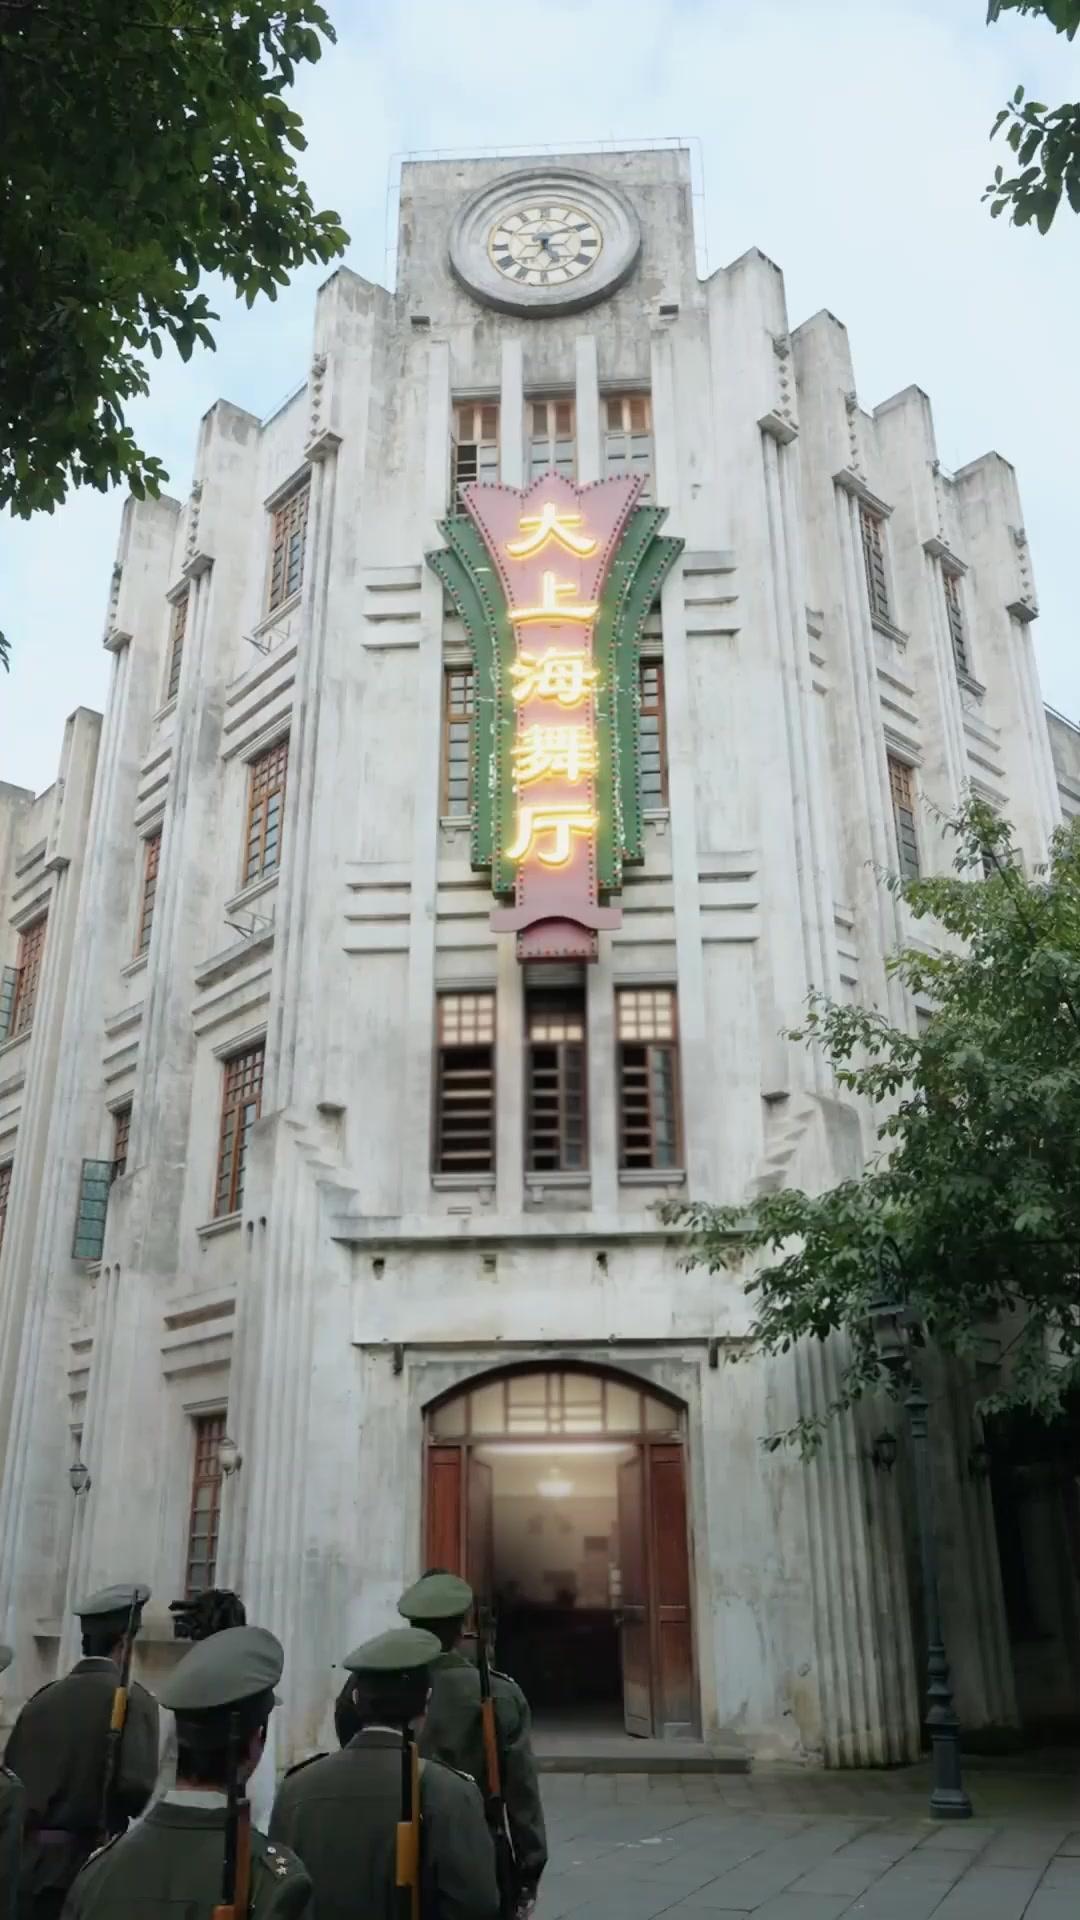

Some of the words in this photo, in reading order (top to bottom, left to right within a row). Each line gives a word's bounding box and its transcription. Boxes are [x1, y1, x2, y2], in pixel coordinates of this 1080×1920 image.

[505, 502, 599, 865] 大上海舞厅
